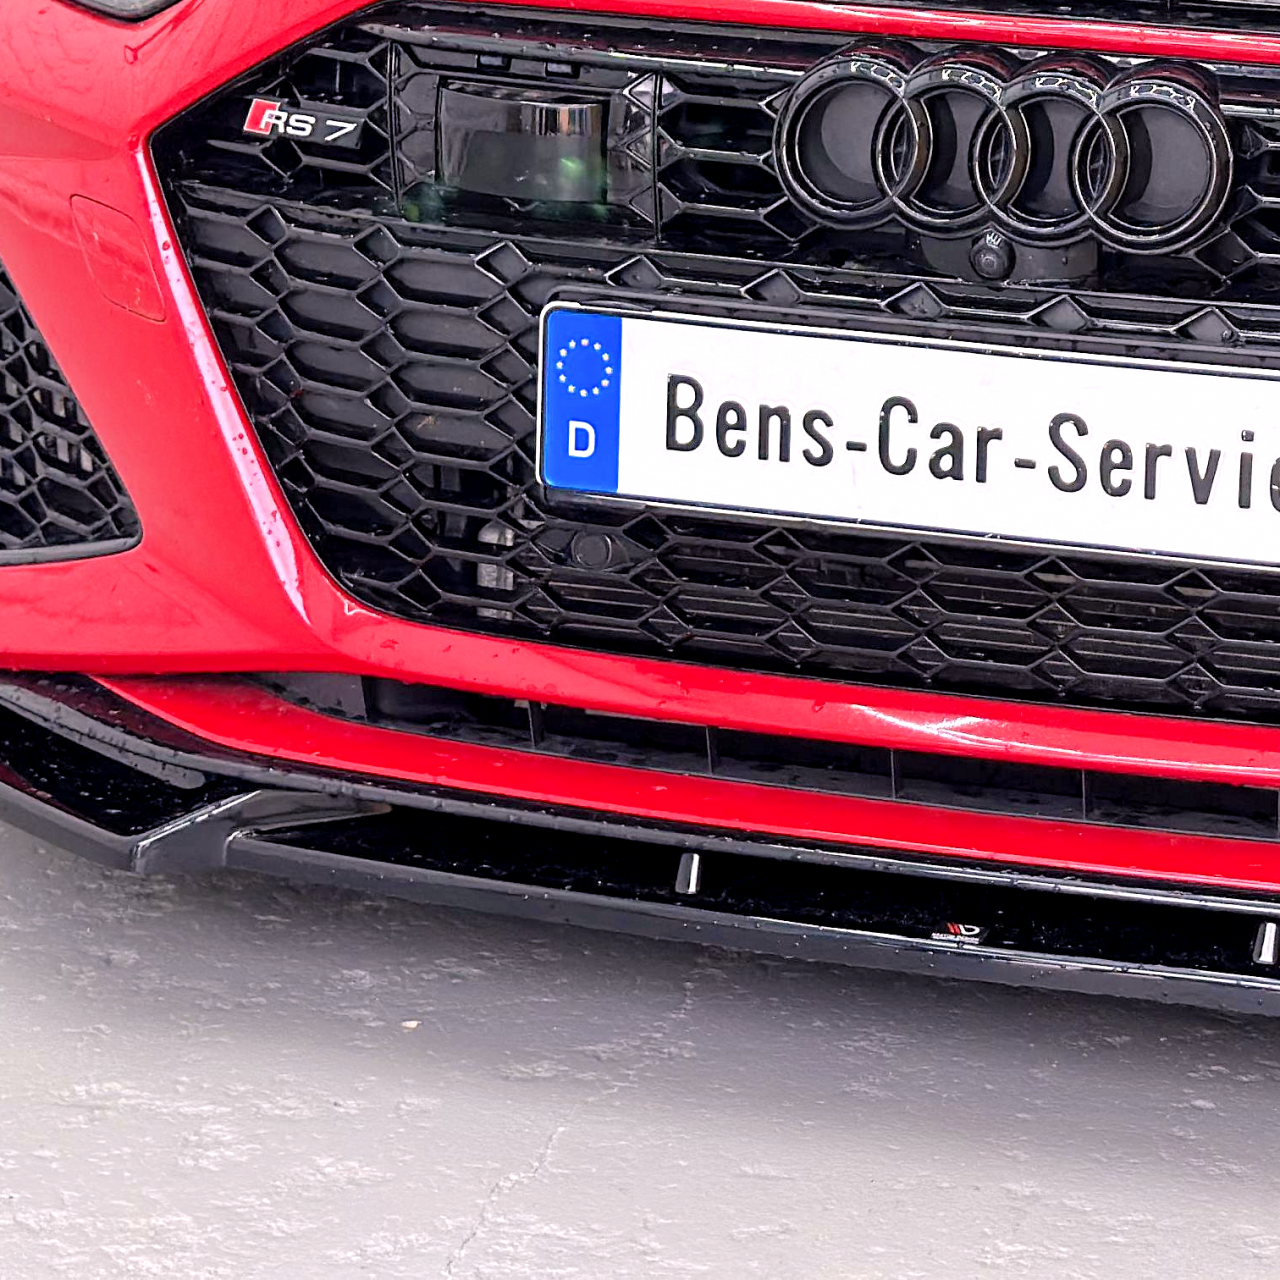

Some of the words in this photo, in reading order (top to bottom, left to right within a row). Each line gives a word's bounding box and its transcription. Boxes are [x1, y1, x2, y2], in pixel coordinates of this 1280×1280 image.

[256, 108, 317, 137] RS
[324, 119, 357, 142] 7
[567, 419, 596, 459] D
